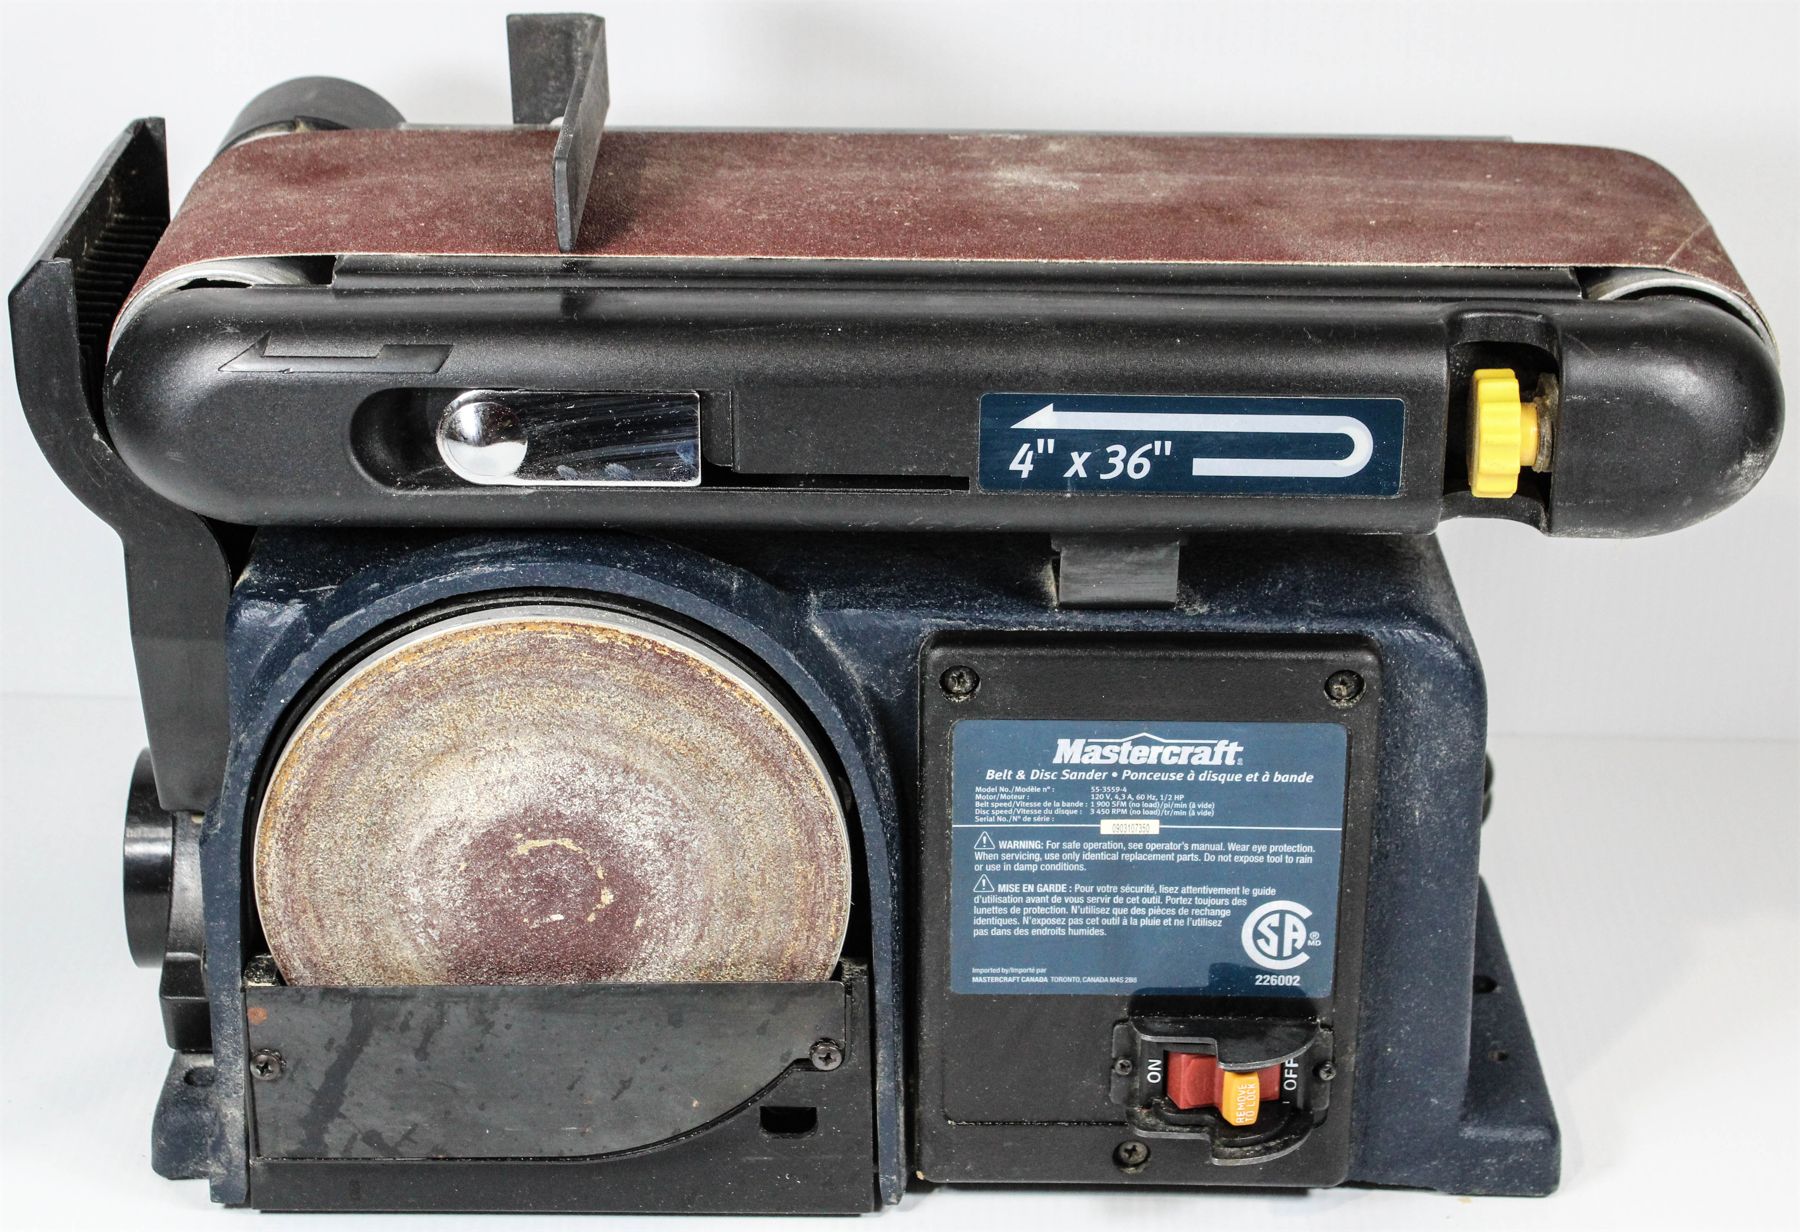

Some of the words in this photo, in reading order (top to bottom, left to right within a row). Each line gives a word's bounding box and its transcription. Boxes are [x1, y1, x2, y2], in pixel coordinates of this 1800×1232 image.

[1009, 439, 1055, 478] 4"
[1063, 450, 1091, 478] x
[1099, 440, 1172, 480] 36"
[1052, 738, 1244, 765] Mastercraft
[986, 769, 1013, 780] Belt
[1016, 770, 1026, 780] &
[1030, 769, 1057, 780] Disc
[1061, 769, 1108, 780] Sander
[1122, 770, 1184, 782] Ponceuse
[1187, 770, 1195, 781] à
[1199, 770, 1242, 784] disque
[1246, 772, 1258, 782] et
[1262, 771, 1270, 782] à
[1273, 772, 1314, 783] bande
[991, 801, 1041, 809] speed/Vitesse
[991, 808, 1041, 816] speed/Vitesse
[999, 840, 1043, 849] WARNING:
[1046, 841, 1060, 849] For
[1062, 841, 1081, 850] safe
[1083, 841, 1126, 852] operation,
[1128, 842, 1143, 850] see
[1146, 842, 1188, 851] operator's
[1191, 842, 1225, 851] manual.
[1228, 843, 1249, 851] Wear
[1252, 844, 1267, 853] eye
[1270, 843, 1315, 854] protection.
[975, 852, 999, 860] When
[1001, 852, 1042, 862] servicing,
[1062, 852, 1080, 862] only
[1082, 852, 1118, 861] identical
[1121, 852, 1174, 863] replacement
[1177, 854, 1201, 863] parts.
[1204, 853, 1216, 862] Do
[1218, 854, 1232, 862] not
[1234, 855, 1264, 864] expose
[1267, 854, 1282, 863] tool
[1286, 855, 1293, 863] to
[1296, 855, 1312, 863] rain
[1003, 863, 1012, 871] in
[1014, 863, 1038, 873] damp
[1040, 863, 1086, 871] conditions.
[998, 884, 1020, 892] MISE
[1022, 884, 1034, 892] EN
[1037, 884, 1067, 893] GARDE
[1075, 884, 1094, 893] Pour
[1097, 885, 1118, 893] votre
[1121, 884, 1157, 895] sécurité,
[1159, 885, 1178, 893] lisez
[1181, 885, 1240, 895] attentivement
[1242, 886, 1250, 895] le
[1252, 887, 1276, 897] guide
[974, 895, 1023, 904] d'utilisation
[1026, 896, 1049, 904] avant
[1051, 895, 1062, 904] de
[1087, 895, 1110, 904] servir
[1113, 895, 1123, 904] de
[1126, 896, 1140, 904] cet
[1142, 896, 1163, 904] outil.
[1165, 897, 1192, 905] Portez
[1195, 897, 1230, 907] toujours
[1232, 898, 1247, 906] des
[973, 906, 1008, 915] lunettes
[1010, 906, 1021, 914] de
[1023, 906, 1068, 916] protection.
[1071, 906, 1109, 915] N'utilisez
[1112, 908, 1128, 917] que
[1131, 906, 1146, 915] des
[1148, 906, 1176, 917] pièces
[1178, 907, 1189, 916] de
[1191, 908, 1231, 918] rechange
[973, 916, 1020, 927] identiques.
[1022, 917, 1066, 927] N'exposez
[1068, 918, 1083, 927] pas
[1086, 917, 1100, 925] cet
[1102, 917, 1120, 925] outil
[1122, 916, 1128, 926] à
[1130, 917, 1138, 926] la
[1140, 917, 1161, 928] pluie
[1163, 918, 1172, 926] et
[1187, 918, 1222, 927] l'utilisez
[973, 928, 988, 938] pas
[991, 927, 1012, 936] dans
[1014, 927, 1029, 936] des
[1032, 927, 1066, 936] endroits
[1068, 927, 1107, 936] humides.
[1241, 900, 1313, 970] CSA
[1255, 975, 1301, 986] 226002
[1147, 1059, 1161, 1083] ON
[1283, 1058, 1299, 1091] OFF
[1247, 1083, 1256, 1107] LOCK
[1235, 1083, 1247, 1123] REMOVE
[1245, 1110, 1255, 1122] TO
